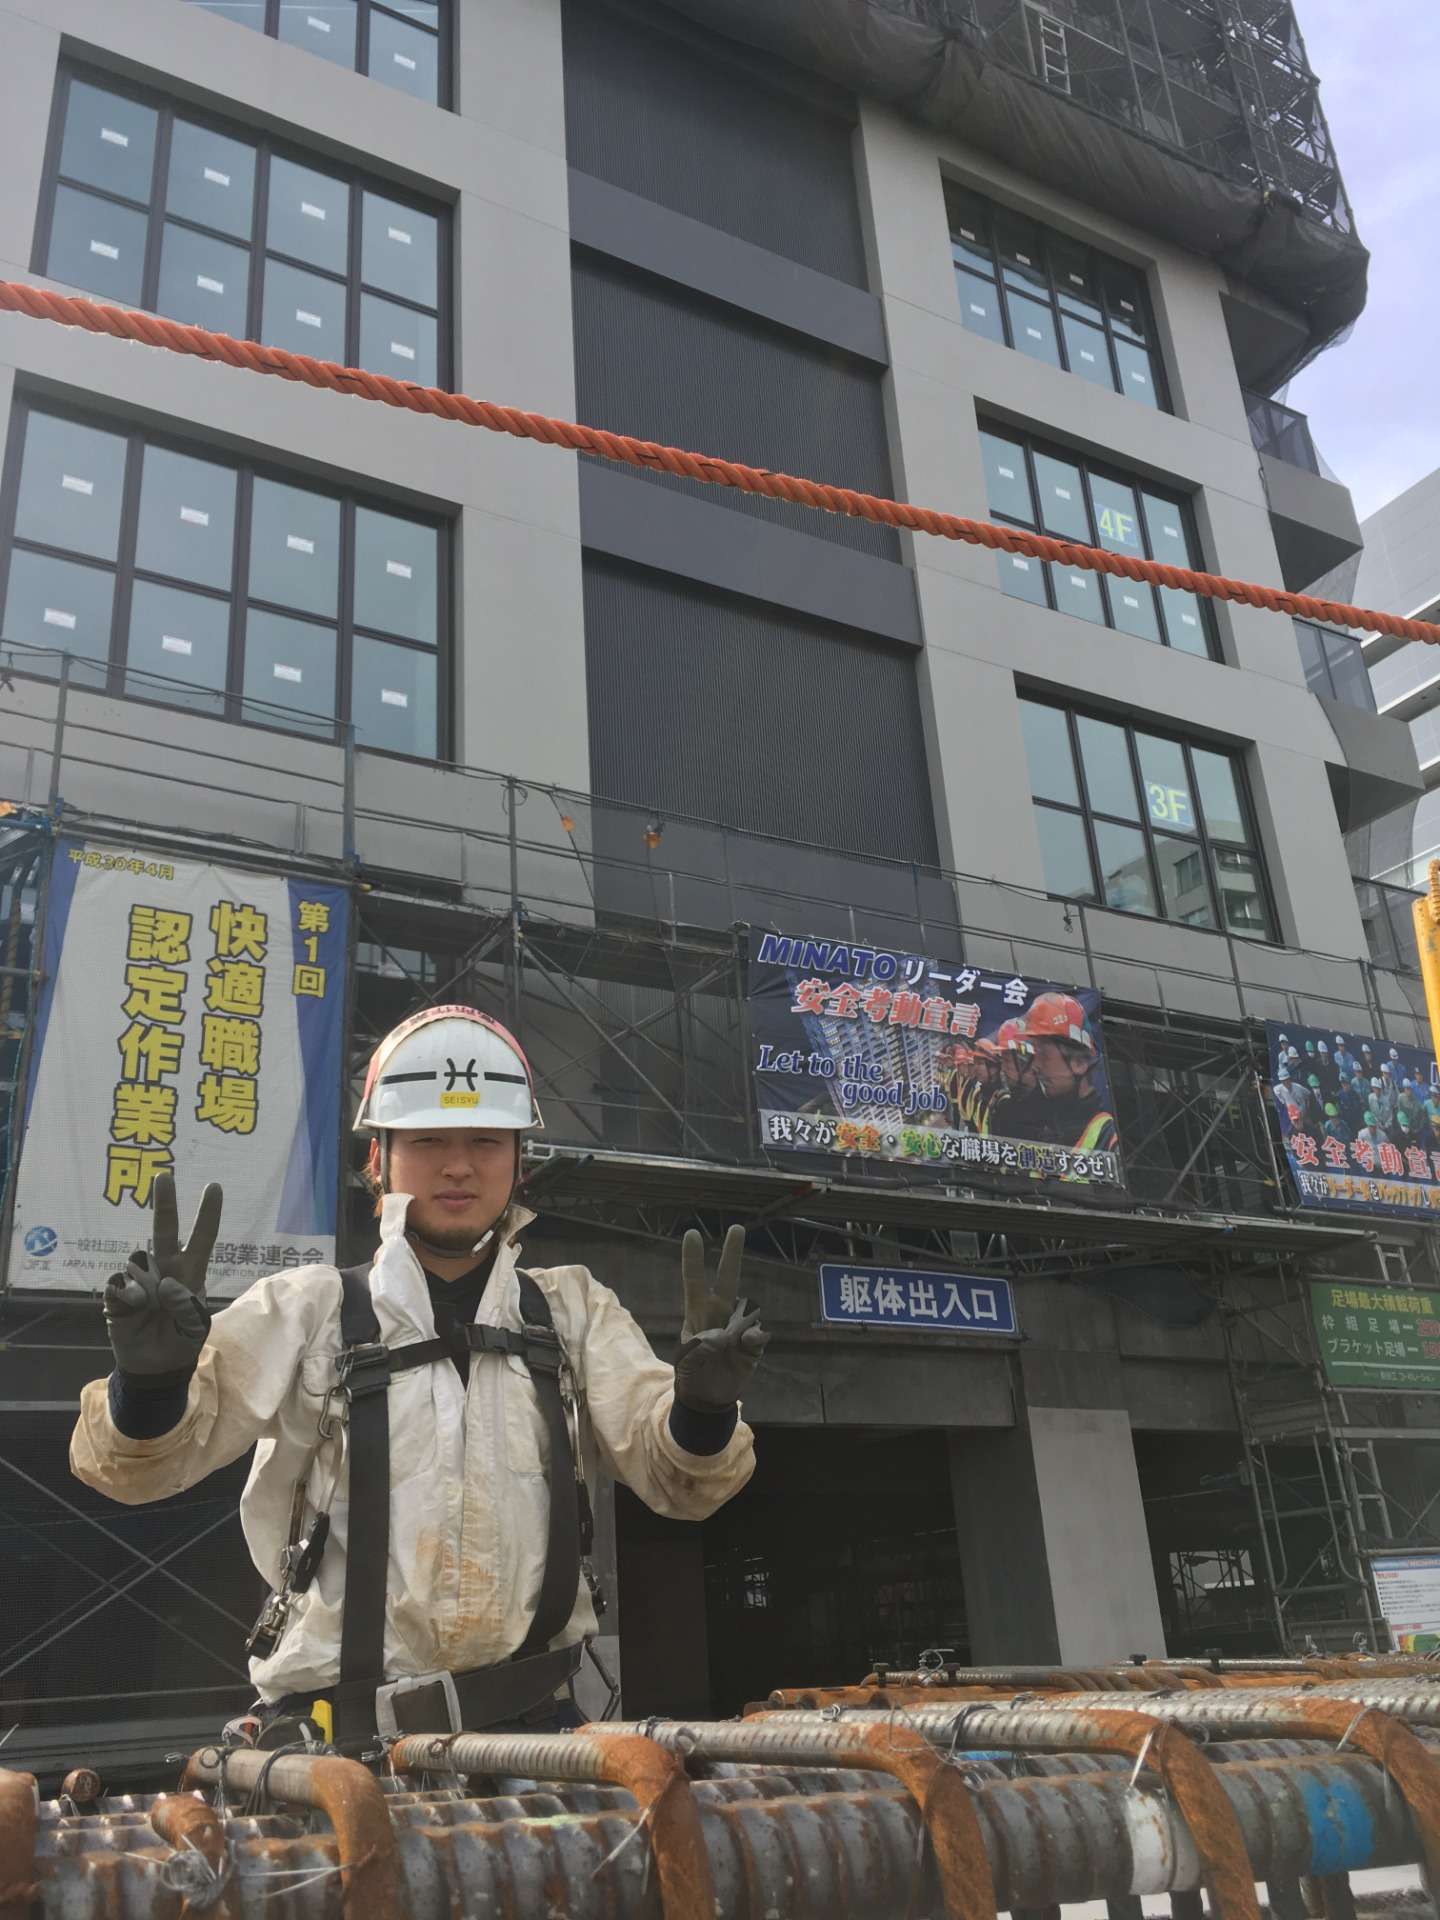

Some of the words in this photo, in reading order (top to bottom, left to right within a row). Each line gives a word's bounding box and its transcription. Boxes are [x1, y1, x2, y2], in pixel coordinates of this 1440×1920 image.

[1100, 509, 1132, 542] 4F
[1150, 784, 1184, 822] 3F
[68, 848, 175, 881] 平成30年4月
[292, 901, 330, 998] 第1回
[757, 934, 897, 980] MINATO
[905, 960, 1029, 1007] リーダー会
[195, 900, 269, 1134] 快適職場
[790, 978, 982, 1038] 安全考動宣言
[103, 904, 194, 1208] 認定作業所
[756, 1044, 802, 1074] Let
[808, 1053, 836, 1078] to
[843, 1055, 883, 1082] the
[843, 1081, 903, 1109] good
[906, 1083, 947, 1115] job
[840, 1274, 998, 1321] 躯体出入口
